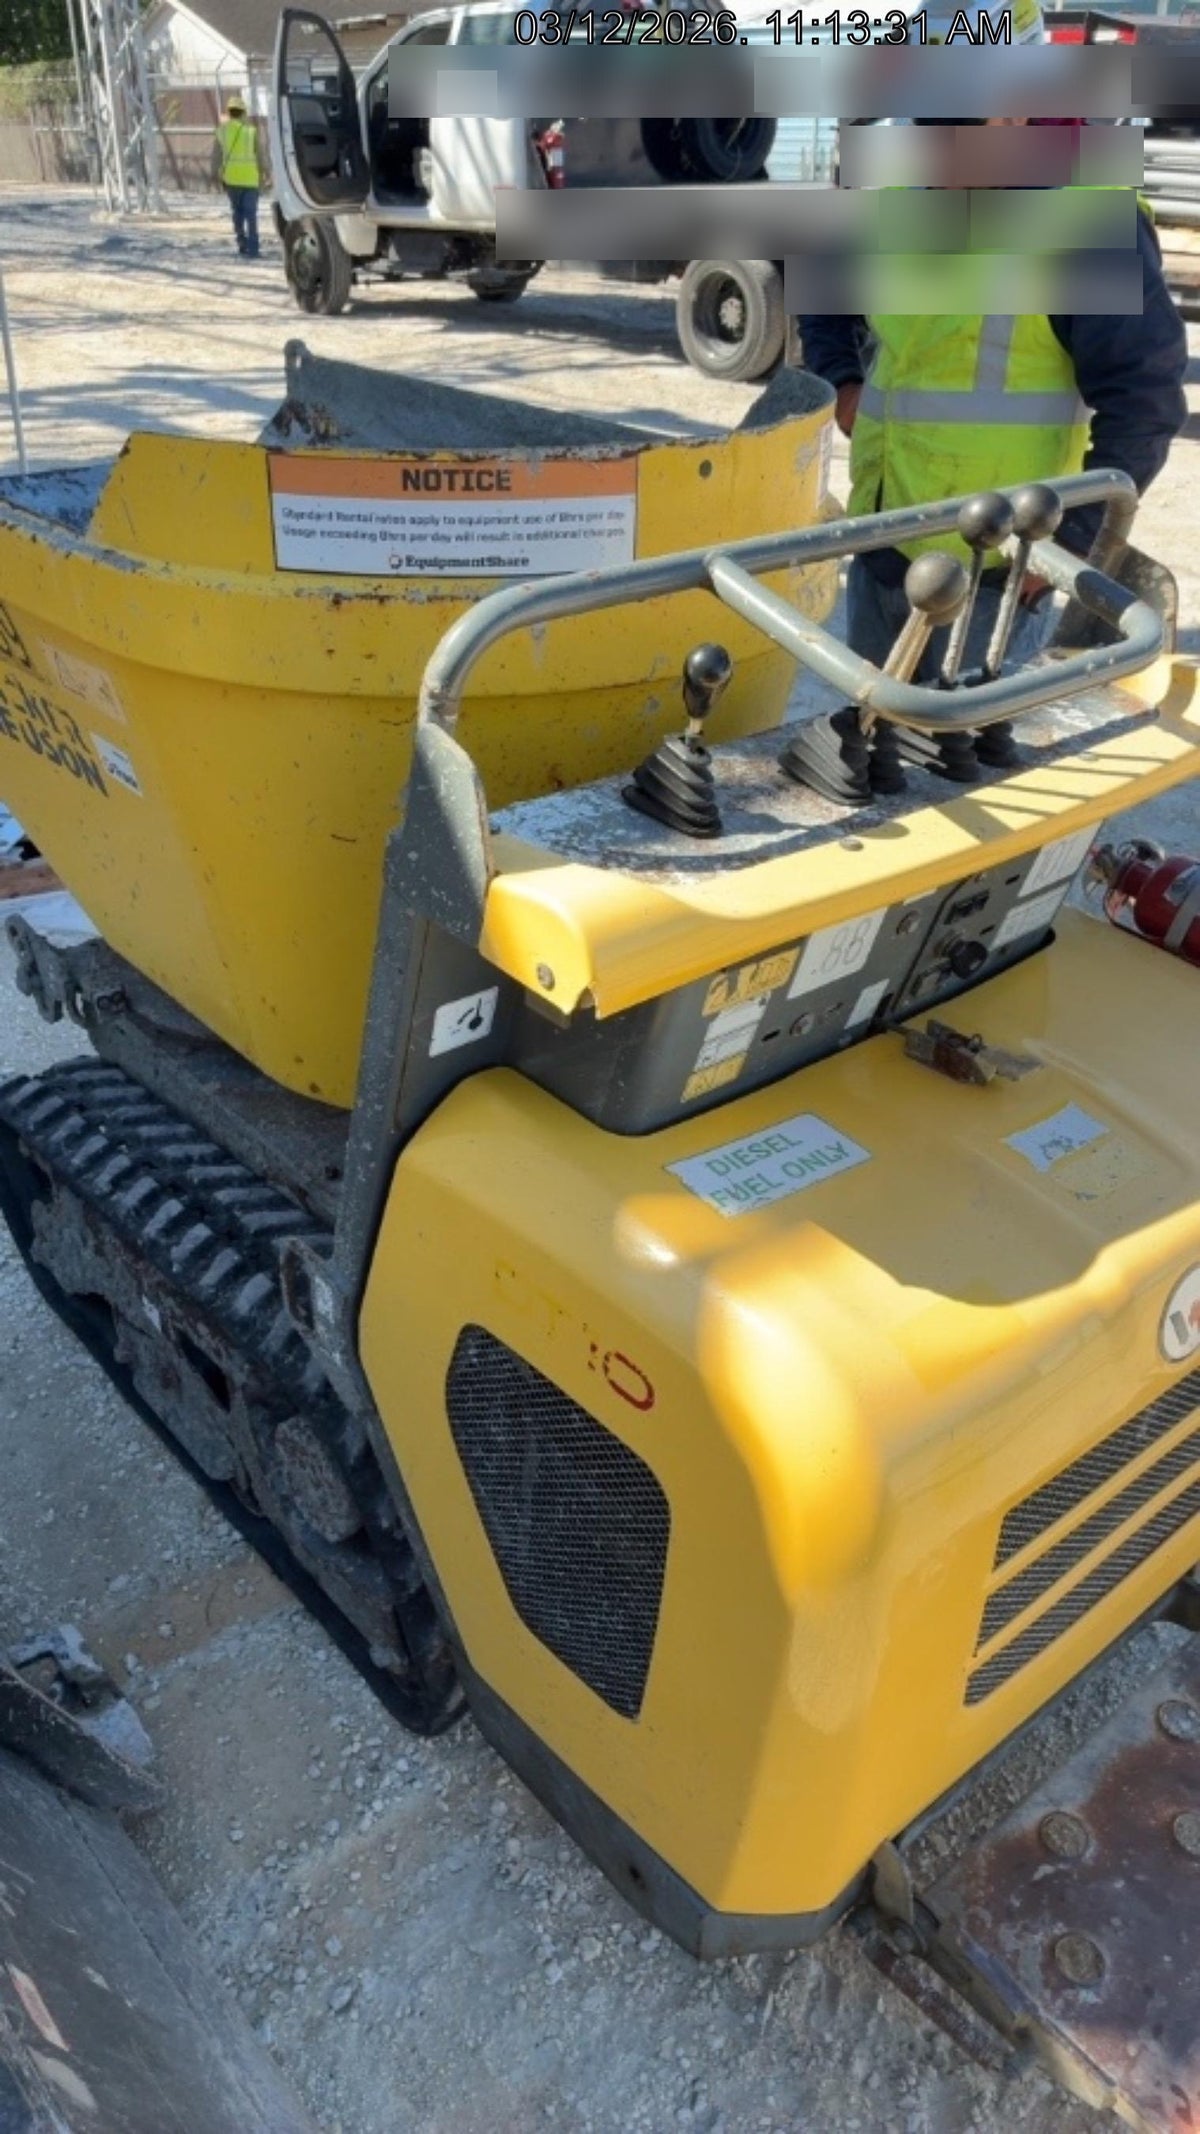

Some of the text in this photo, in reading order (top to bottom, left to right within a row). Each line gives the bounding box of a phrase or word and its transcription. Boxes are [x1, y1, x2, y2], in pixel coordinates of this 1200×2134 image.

[402, 468, 512, 492] NOTICE
[336, 510, 373, 523] Rental
[375, 514, 406, 525] rates
[409, 514, 440, 527] apply
[443, 515, 456, 525] to
[457, 514, 520, 527] equipment
[523, 515, 543, 525] use
[545, 512, 557, 523] of
[585, 512, 603, 523] per
[281, 525, 316, 539] Usage
[319, 530, 378, 543] exceeding
[409, 532, 428, 543] per
[430, 531, 452, 544] day
[454, 530, 474, 543] will
[476, 530, 511, 542] result
[513, 530, 524, 541] in
[526, 528, 581, 541] additional
[405, 554, 530, 570] EquipmentShare
[0, 703, 110, 798] EUSON
[704, 1132, 804, 1177] DIESEL
[708, 1140, 851, 1208] FUEL ONLY
